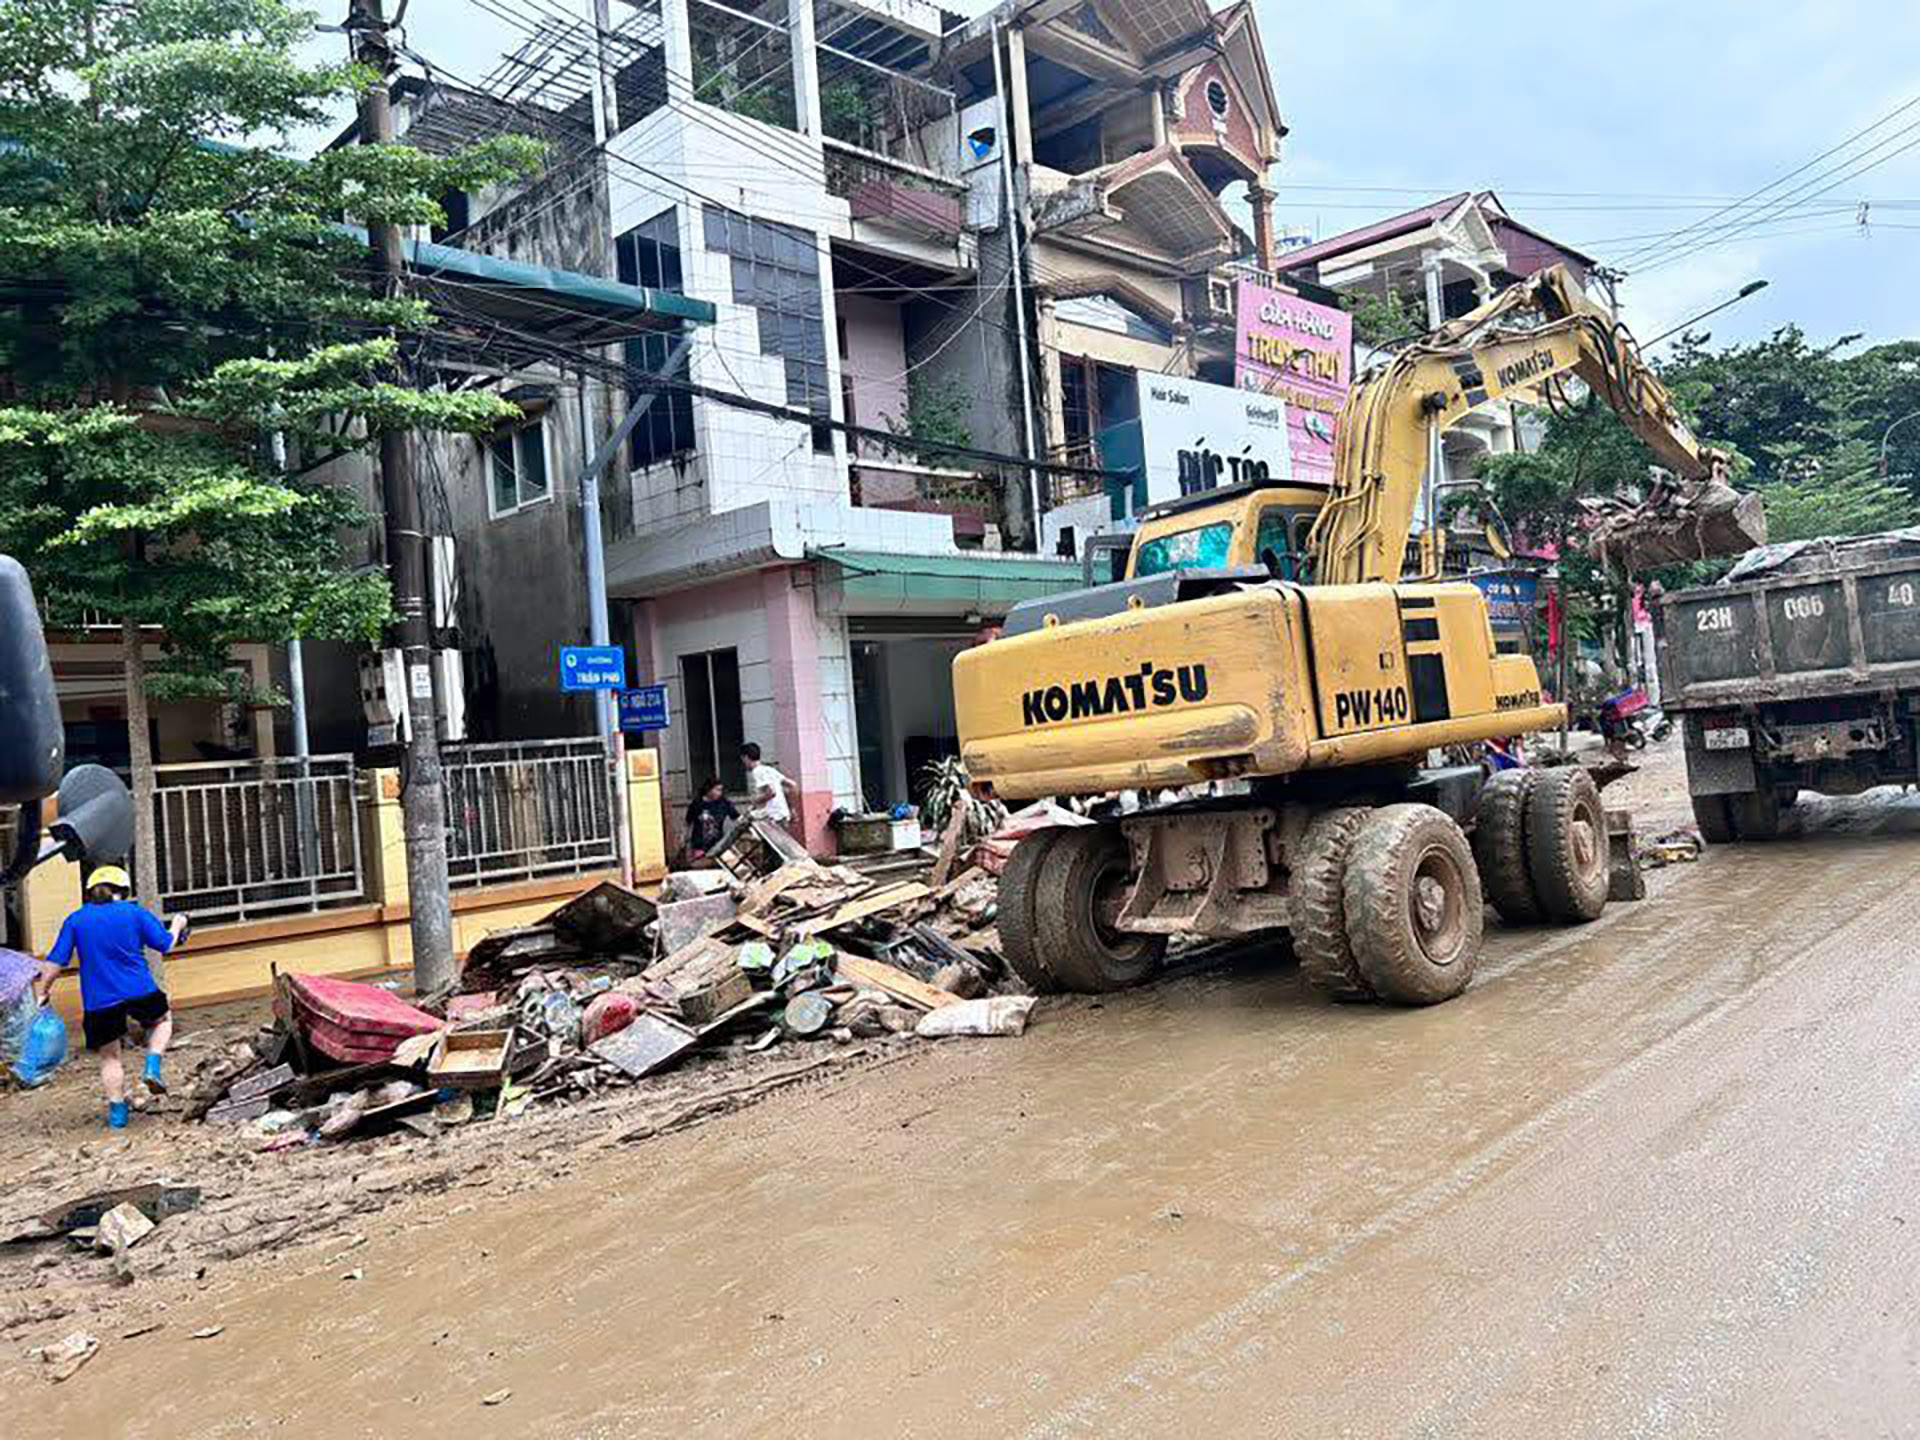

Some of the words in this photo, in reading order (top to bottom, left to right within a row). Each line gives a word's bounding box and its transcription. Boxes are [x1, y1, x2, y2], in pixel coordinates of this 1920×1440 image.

[1497, 347, 1555, 389] KOMATSU
[1168, 389, 1190, 405] Salon
[1887, 583, 1914, 606] 40
[1696, 606, 1732, 631] 23H
[1023, 661, 1209, 726] KOMATSU
[1495, 689, 1540, 708] KOMATSU
[1335, 686, 1408, 728] PW140
